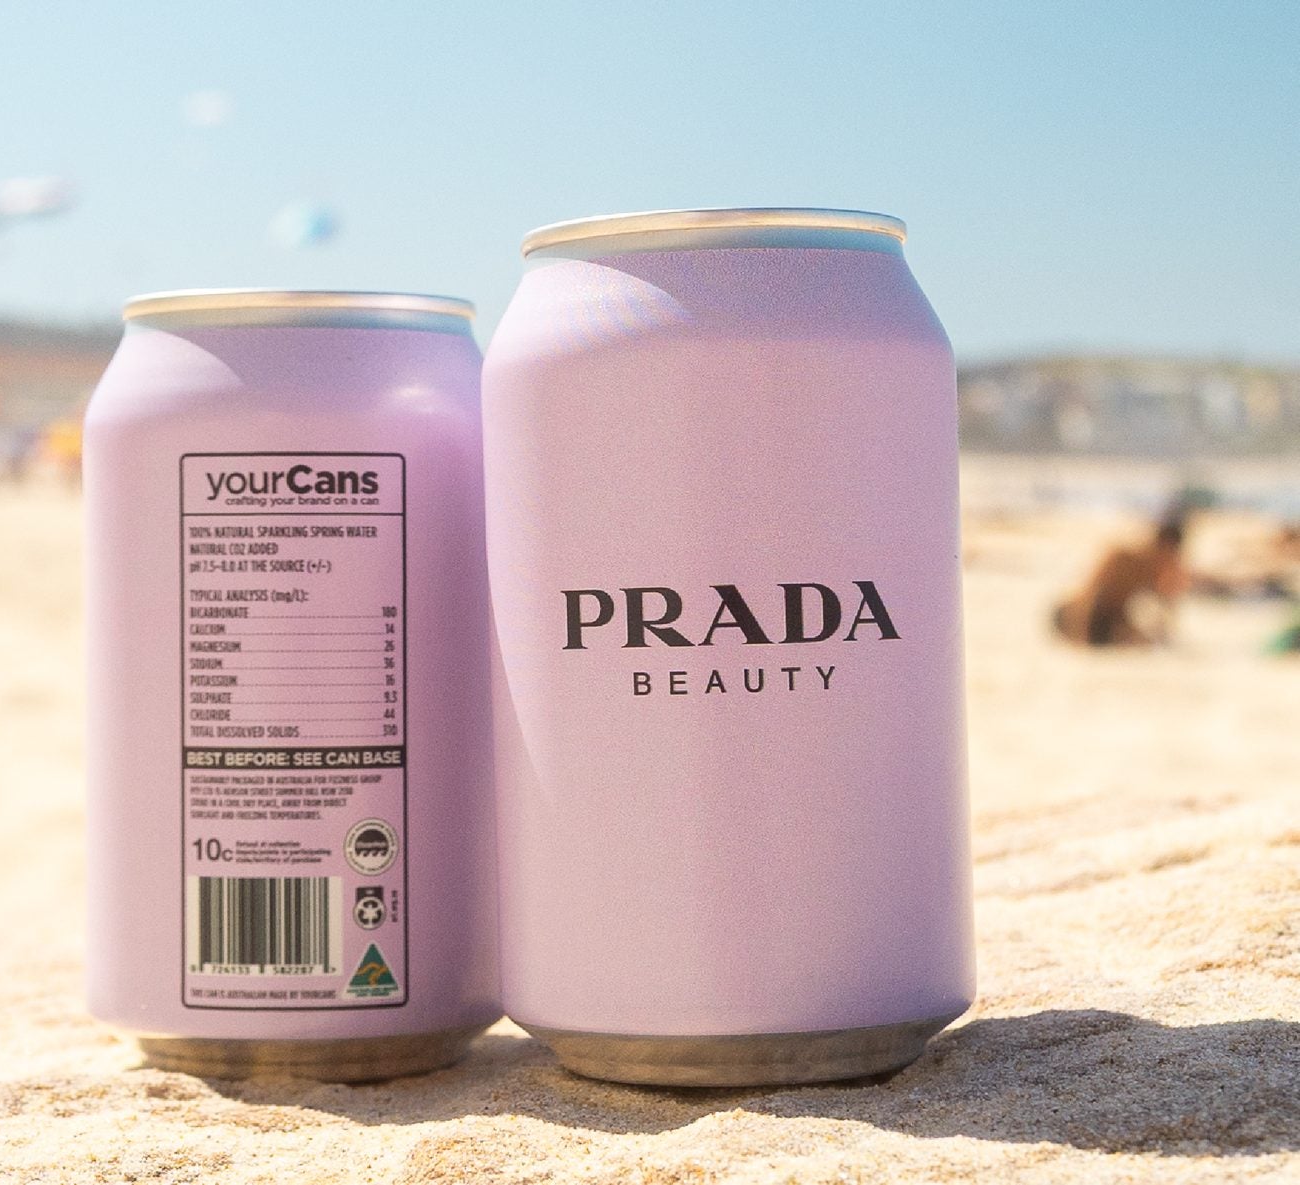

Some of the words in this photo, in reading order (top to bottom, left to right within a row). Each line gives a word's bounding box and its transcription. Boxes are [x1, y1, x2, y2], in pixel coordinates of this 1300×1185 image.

[206, 464, 379, 501] yourCans
[225, 496, 267, 507] crafting
[269, 497, 295, 507] your
[299, 496, 331, 505] brand
[189, 527, 211, 538] 100%
[214, 527, 253, 538] NATURAL
[257, 526, 308, 538] SPARKLING
[310, 526, 344, 538] SPRING
[346, 526, 378, 538] WATER
[189, 543, 227, 555] NATURAL
[229, 543, 245, 555] CO2
[247, 542, 279, 555] ADDED
[189, 561, 201, 573] pH
[237, 560, 248, 572] AT
[251, 560, 267, 572] THE
[269, 560, 305, 572] SOURCE
[190, 590, 223, 601] TYPICAL
[225, 590, 268, 601] ANALYSIS
[190, 607, 249, 618] BICARBONATE
[560, 581, 902, 650] PRADA
[190, 624, 226, 635] CALCIUM
[190, 641, 242, 652] MAGNESIUM
[190, 658, 223, 669] SODIUM
[190, 675, 239, 686] POTASSIUM
[633, 666, 835, 696] BEAUTY
[190, 692, 232, 704] SULPHATE
[190, 709, 231, 721] CHLORIDE
[190, 726, 215, 737] TOTAL
[216, 726, 265, 737] DISSOLVED
[267, 726, 300, 737] SOLIDS
[187, 752, 221, 765] BEST
[224, 752, 290, 765] BEFORE:
[293, 752, 323, 765] SEE
[326, 752, 359, 764] CAN
[362, 751, 401, 764] BASE
[192, 838, 233, 861] 10c
